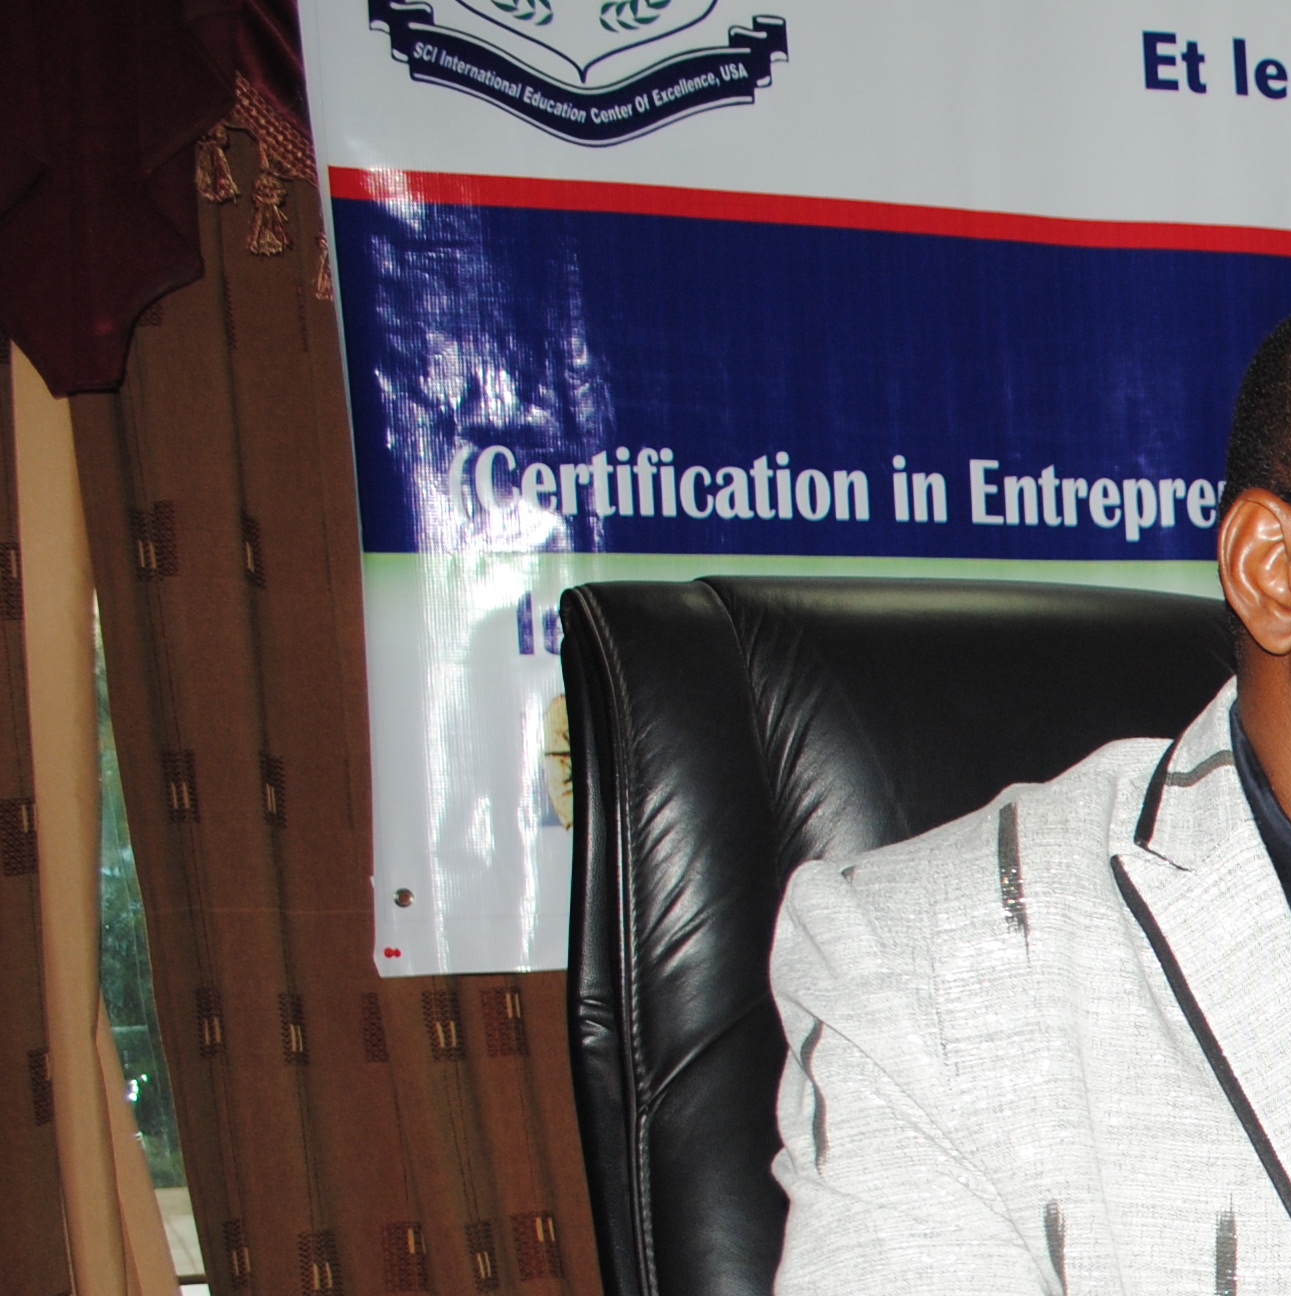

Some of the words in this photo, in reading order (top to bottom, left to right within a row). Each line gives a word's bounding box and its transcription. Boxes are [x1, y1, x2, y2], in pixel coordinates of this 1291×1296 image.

[413, 42, 438, 63] SCI
[440, 50, 522, 99] International
[523, 87, 587, 124] Education
[590, 101, 634, 125] Center
[635, 93, 649, 113] Of
[652, 72, 721, 108] Excellence,
[719, 62, 748, 82] USA
[1142, 30, 1207, 94] Et
[1233, 39, 1289, 100] le
[448, 445, 869, 524] (Certification
[892, 454, 948, 524] in
